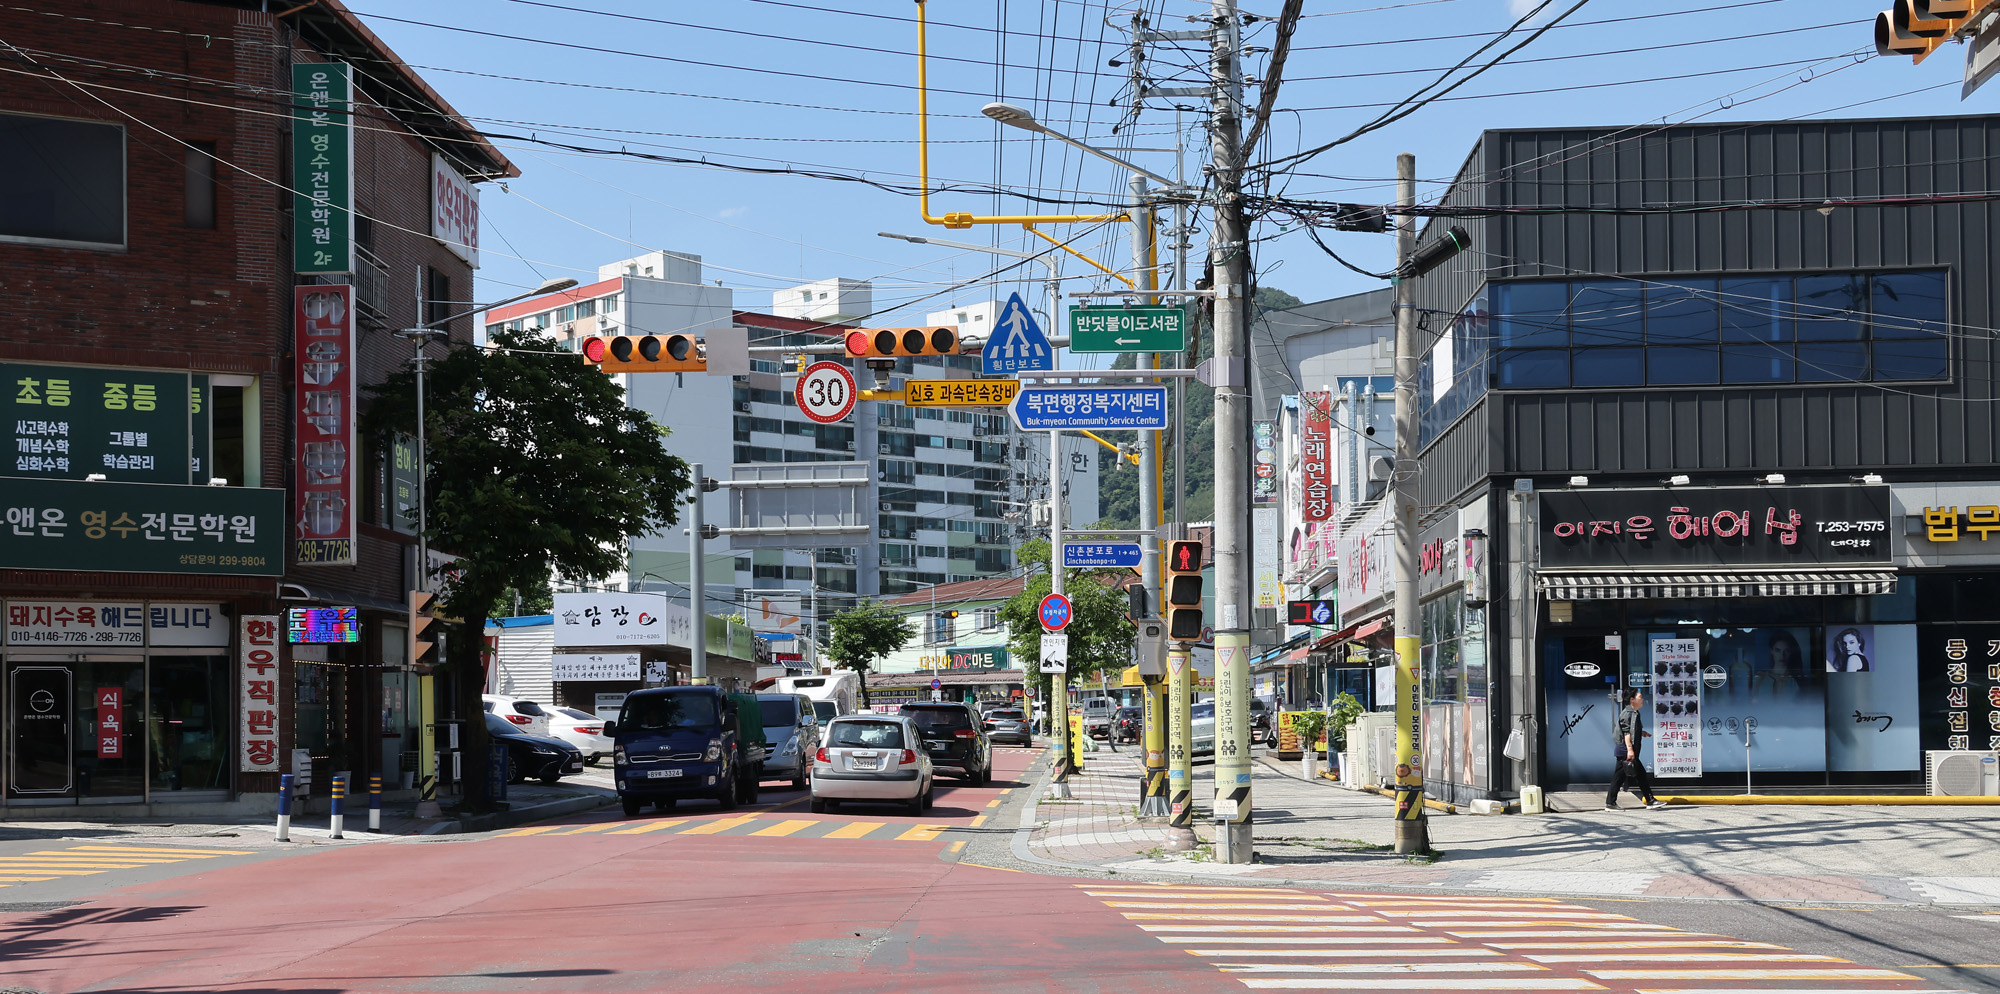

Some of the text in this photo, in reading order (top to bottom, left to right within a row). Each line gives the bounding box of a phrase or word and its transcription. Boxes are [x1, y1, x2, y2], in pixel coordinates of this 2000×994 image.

[308, 71, 333, 267] 온앤온 영수전문학원 2F
[437, 169, 478, 254] 한우직판장
[1076, 315, 1180, 332] 반딧불이도서관
[992, 358, 1042, 371] 횡단보도
[15, 376, 72, 408] 초등
[102, 382, 157, 412] 중등
[808, 378, 844, 407] 30
[910, 384, 1016, 403] 신호 과속단속장비
[1026, 392, 1160, 414] 북면행정복지센터
[15, 419, 70, 437] 사고력수학
[1026, 416, 1160, 427] Buk-myeon Community Service Center
[15, 437, 70, 455] 개념수학
[109, 431, 148, 447] 그룹별
[15, 455, 70, 473] 심화수학
[102, 453, 155, 470] 학습관리
[1305, 426, 1330, 518] 노래연습장
[0, 507, 256, 543] 앤온 영수전문학원
[1553, 506, 1802, 546] 이지은 헤어 샵
[1816, 520, 1885, 533] T.253-7575
[178, 554, 266, 567] 상담문의 299-9804
[297, 539, 350, 563] 298-7726
[1066, 546, 1114, 557] 신촌본포로
[1258, 570, 1275, 592] 세탁
[9, 605, 212, 629] 돼지수육 해드립니다
[11, 631, 142, 643] 010-4146-7726 298-7726
[1655, 643, 1696, 653] 조각 커트
[246, 619, 277, 766] 한우직판장
[1173, 678, 1181, 703] 어린이
[1223, 671, 1234, 735] 어린이 보호구역
[102, 691, 118, 754] 식육점
[1411, 684, 1420, 751] 어린이 보호구역
